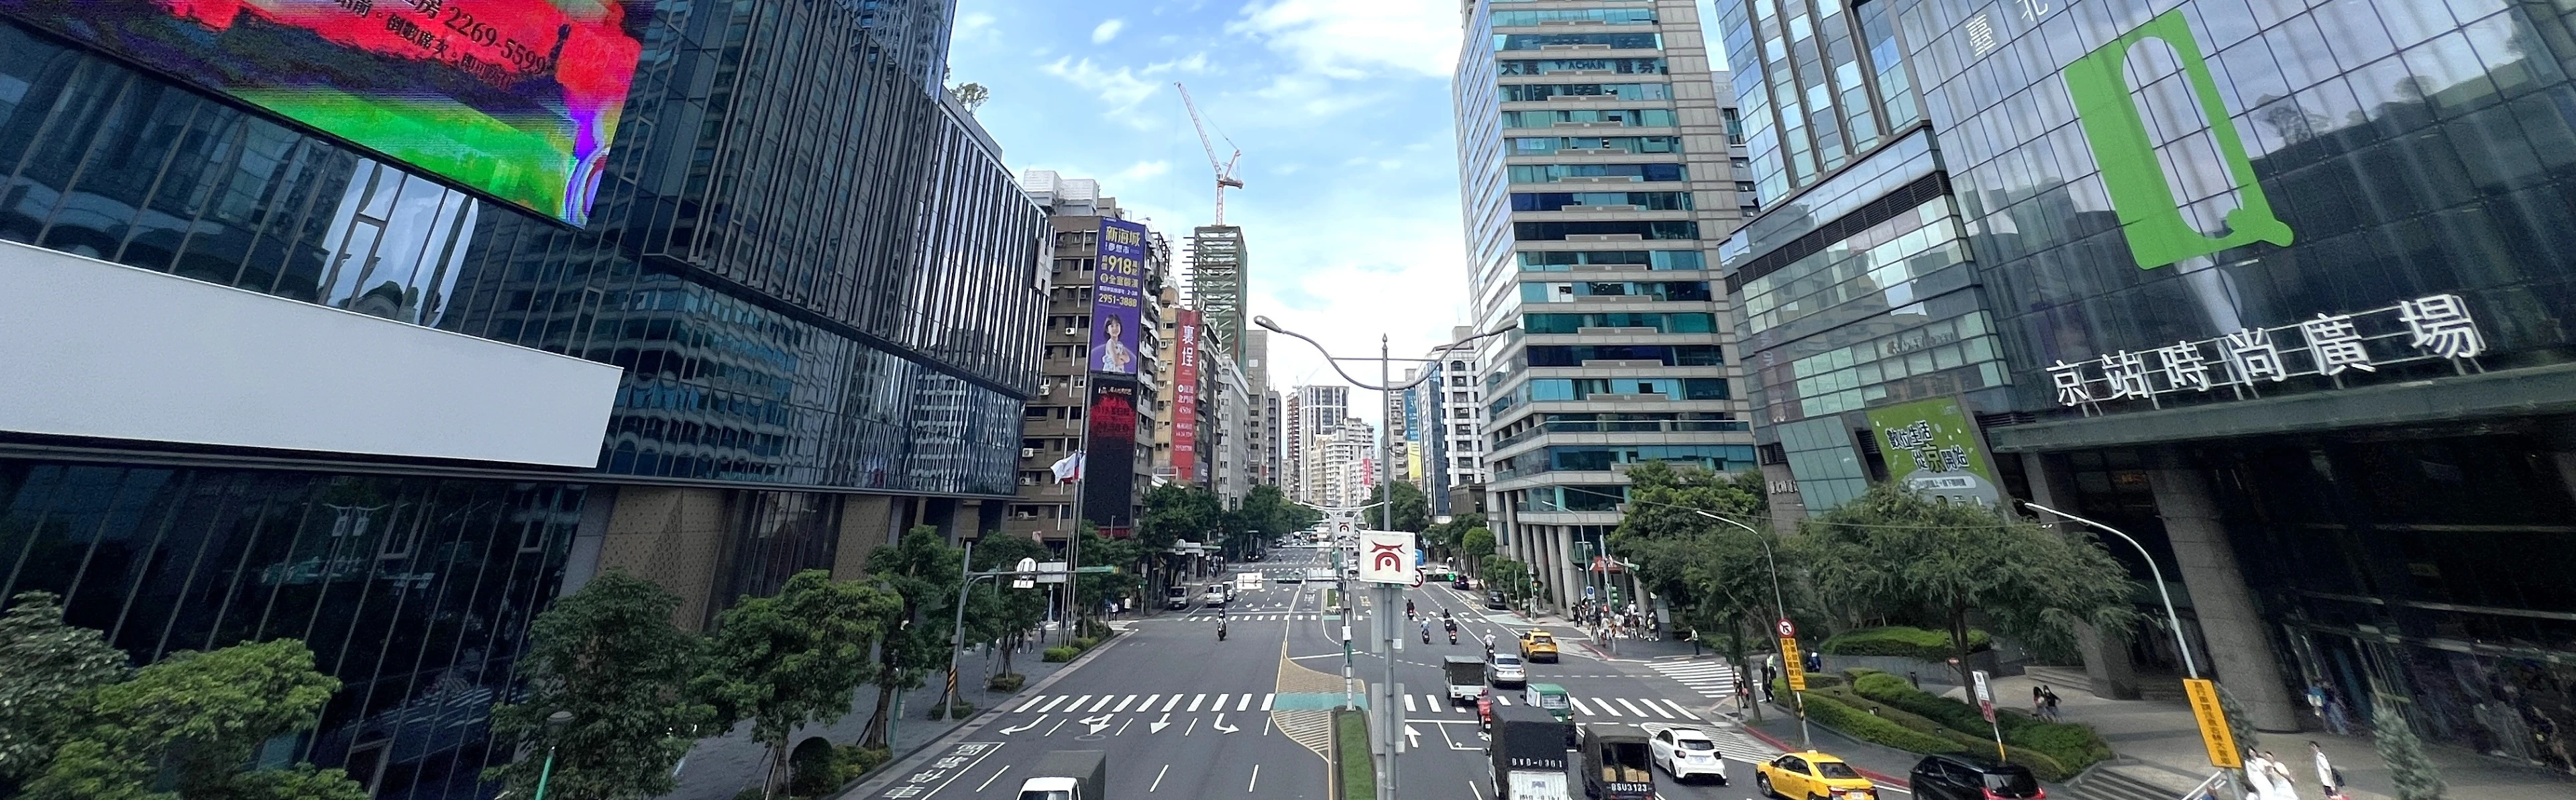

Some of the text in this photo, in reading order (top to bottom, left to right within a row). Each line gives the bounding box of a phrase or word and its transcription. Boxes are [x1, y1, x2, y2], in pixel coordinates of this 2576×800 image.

[443, 6, 547, 74] 2269-5599
[1106, 226, 1140, 247] 新海城
[1108, 255, 1132, 275] 918
[2047, 293, 2485, 407] 京站時尚廣場
[1885, 419, 1933, 450] 數位生活
[1911, 442, 1970, 473] 從京開始
